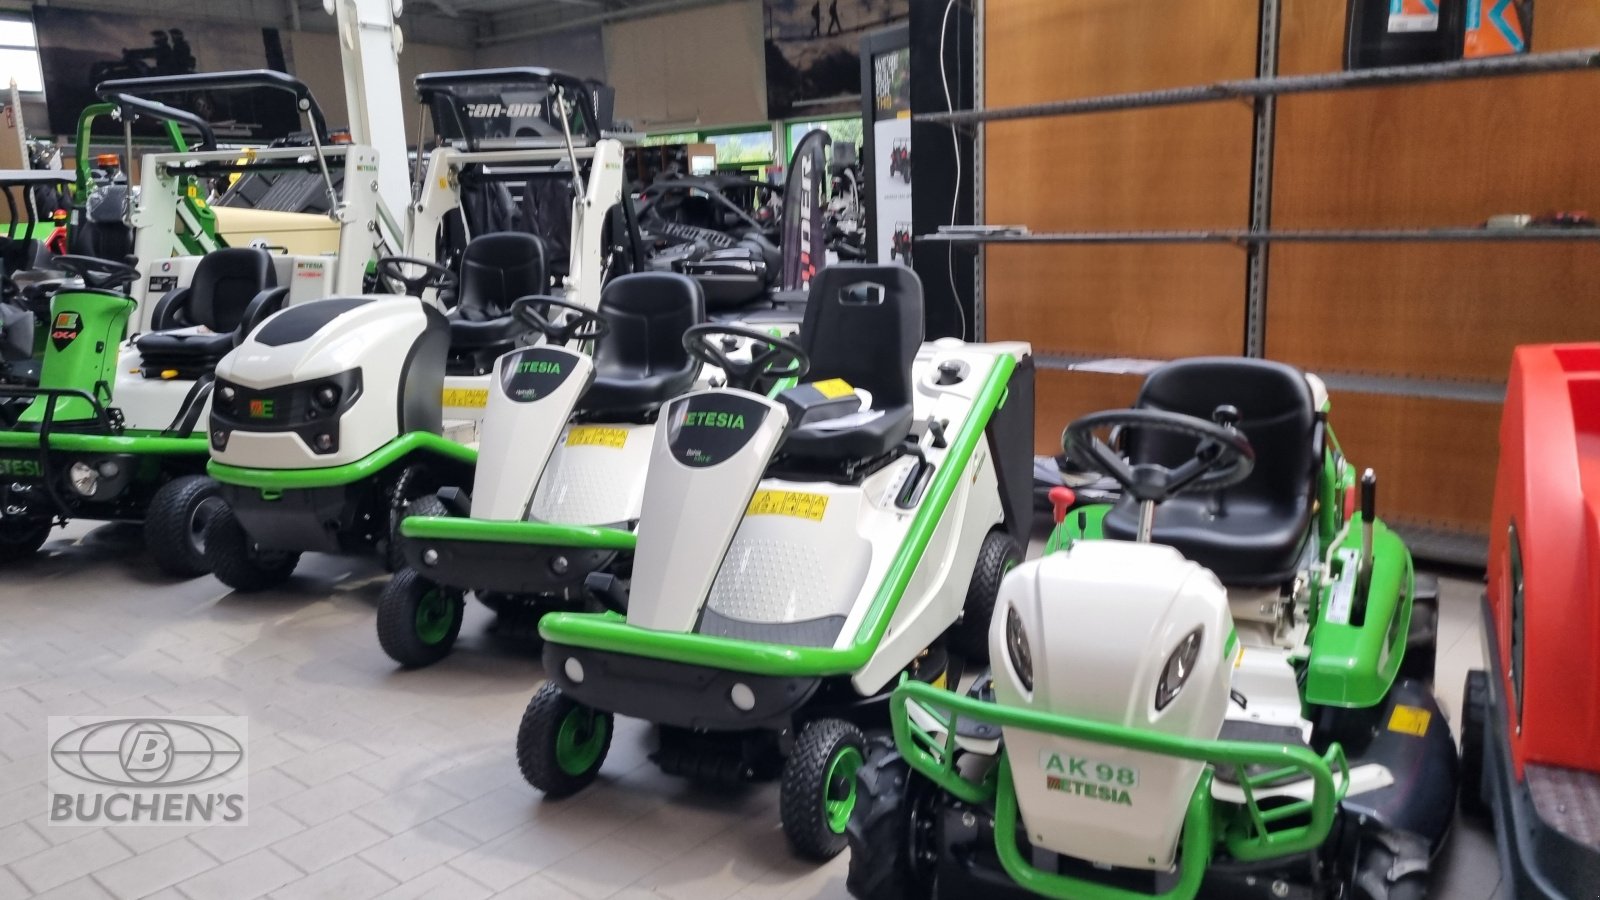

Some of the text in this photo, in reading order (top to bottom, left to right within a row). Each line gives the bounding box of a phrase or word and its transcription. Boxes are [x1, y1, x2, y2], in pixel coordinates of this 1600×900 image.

[684, 411, 745, 430] ETESIA
[1046, 752, 1135, 787] AK 98
[1047, 775, 1133, 806] ETESIA
